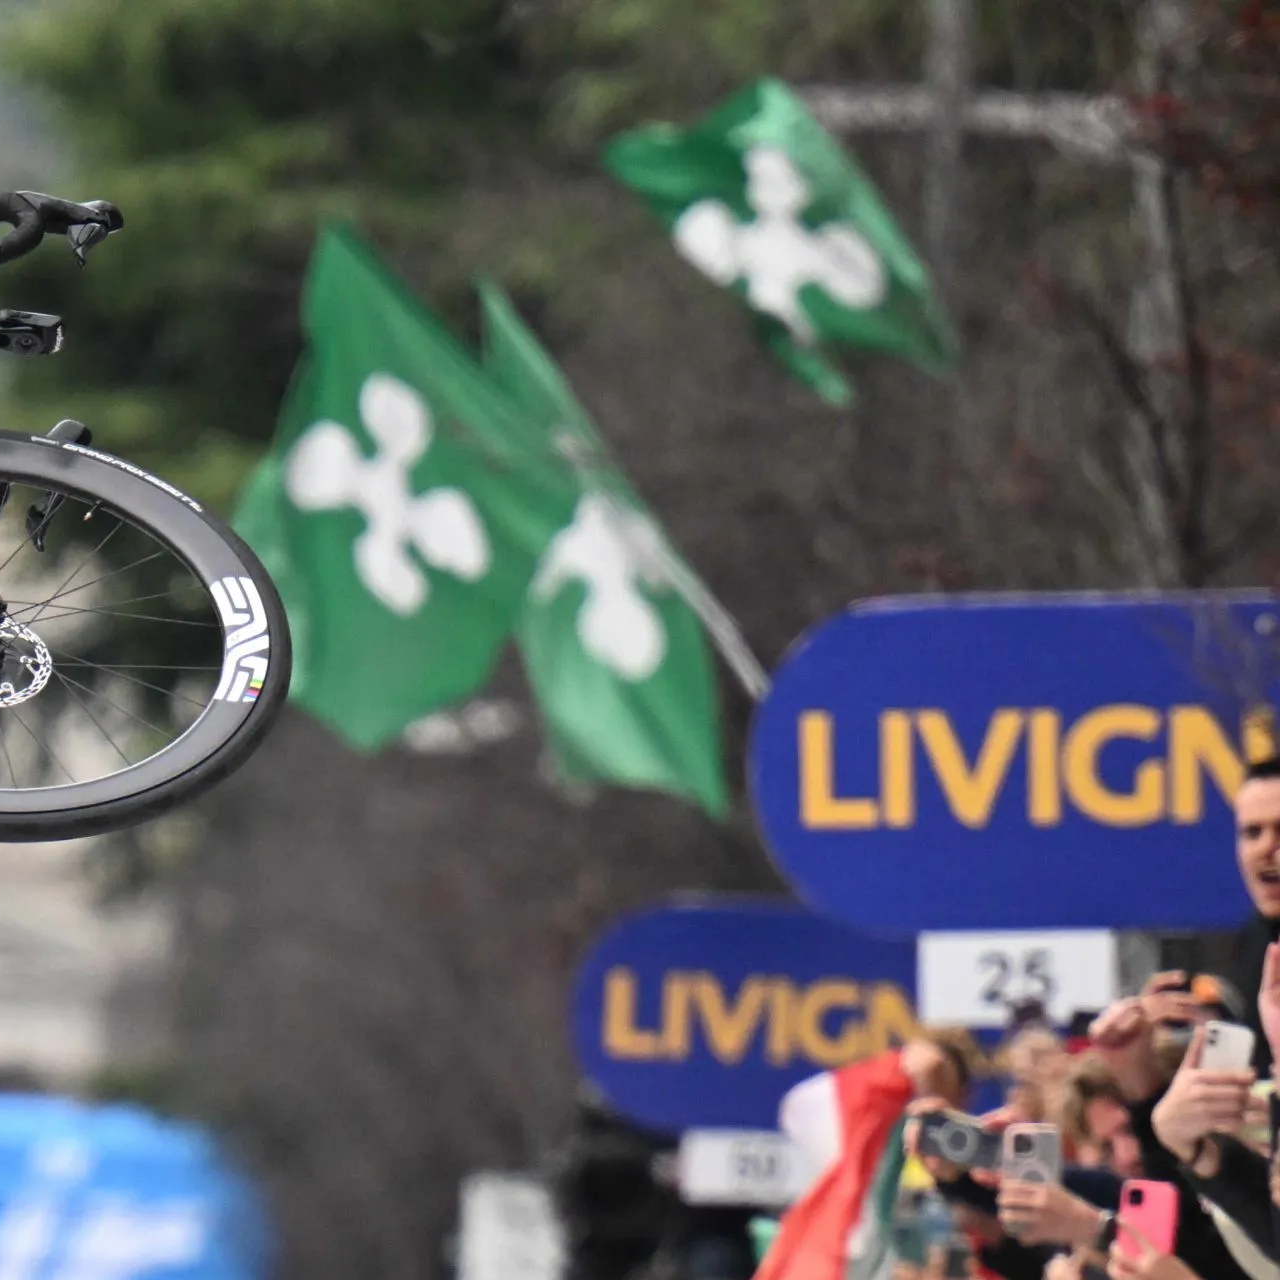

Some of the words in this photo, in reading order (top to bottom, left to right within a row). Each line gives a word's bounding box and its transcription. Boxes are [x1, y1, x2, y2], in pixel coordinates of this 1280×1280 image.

[798, 704, 1273, 830] LIVIGN
[602, 966, 940, 1068] LIVIGN
[977, 949, 1057, 1003] 25
